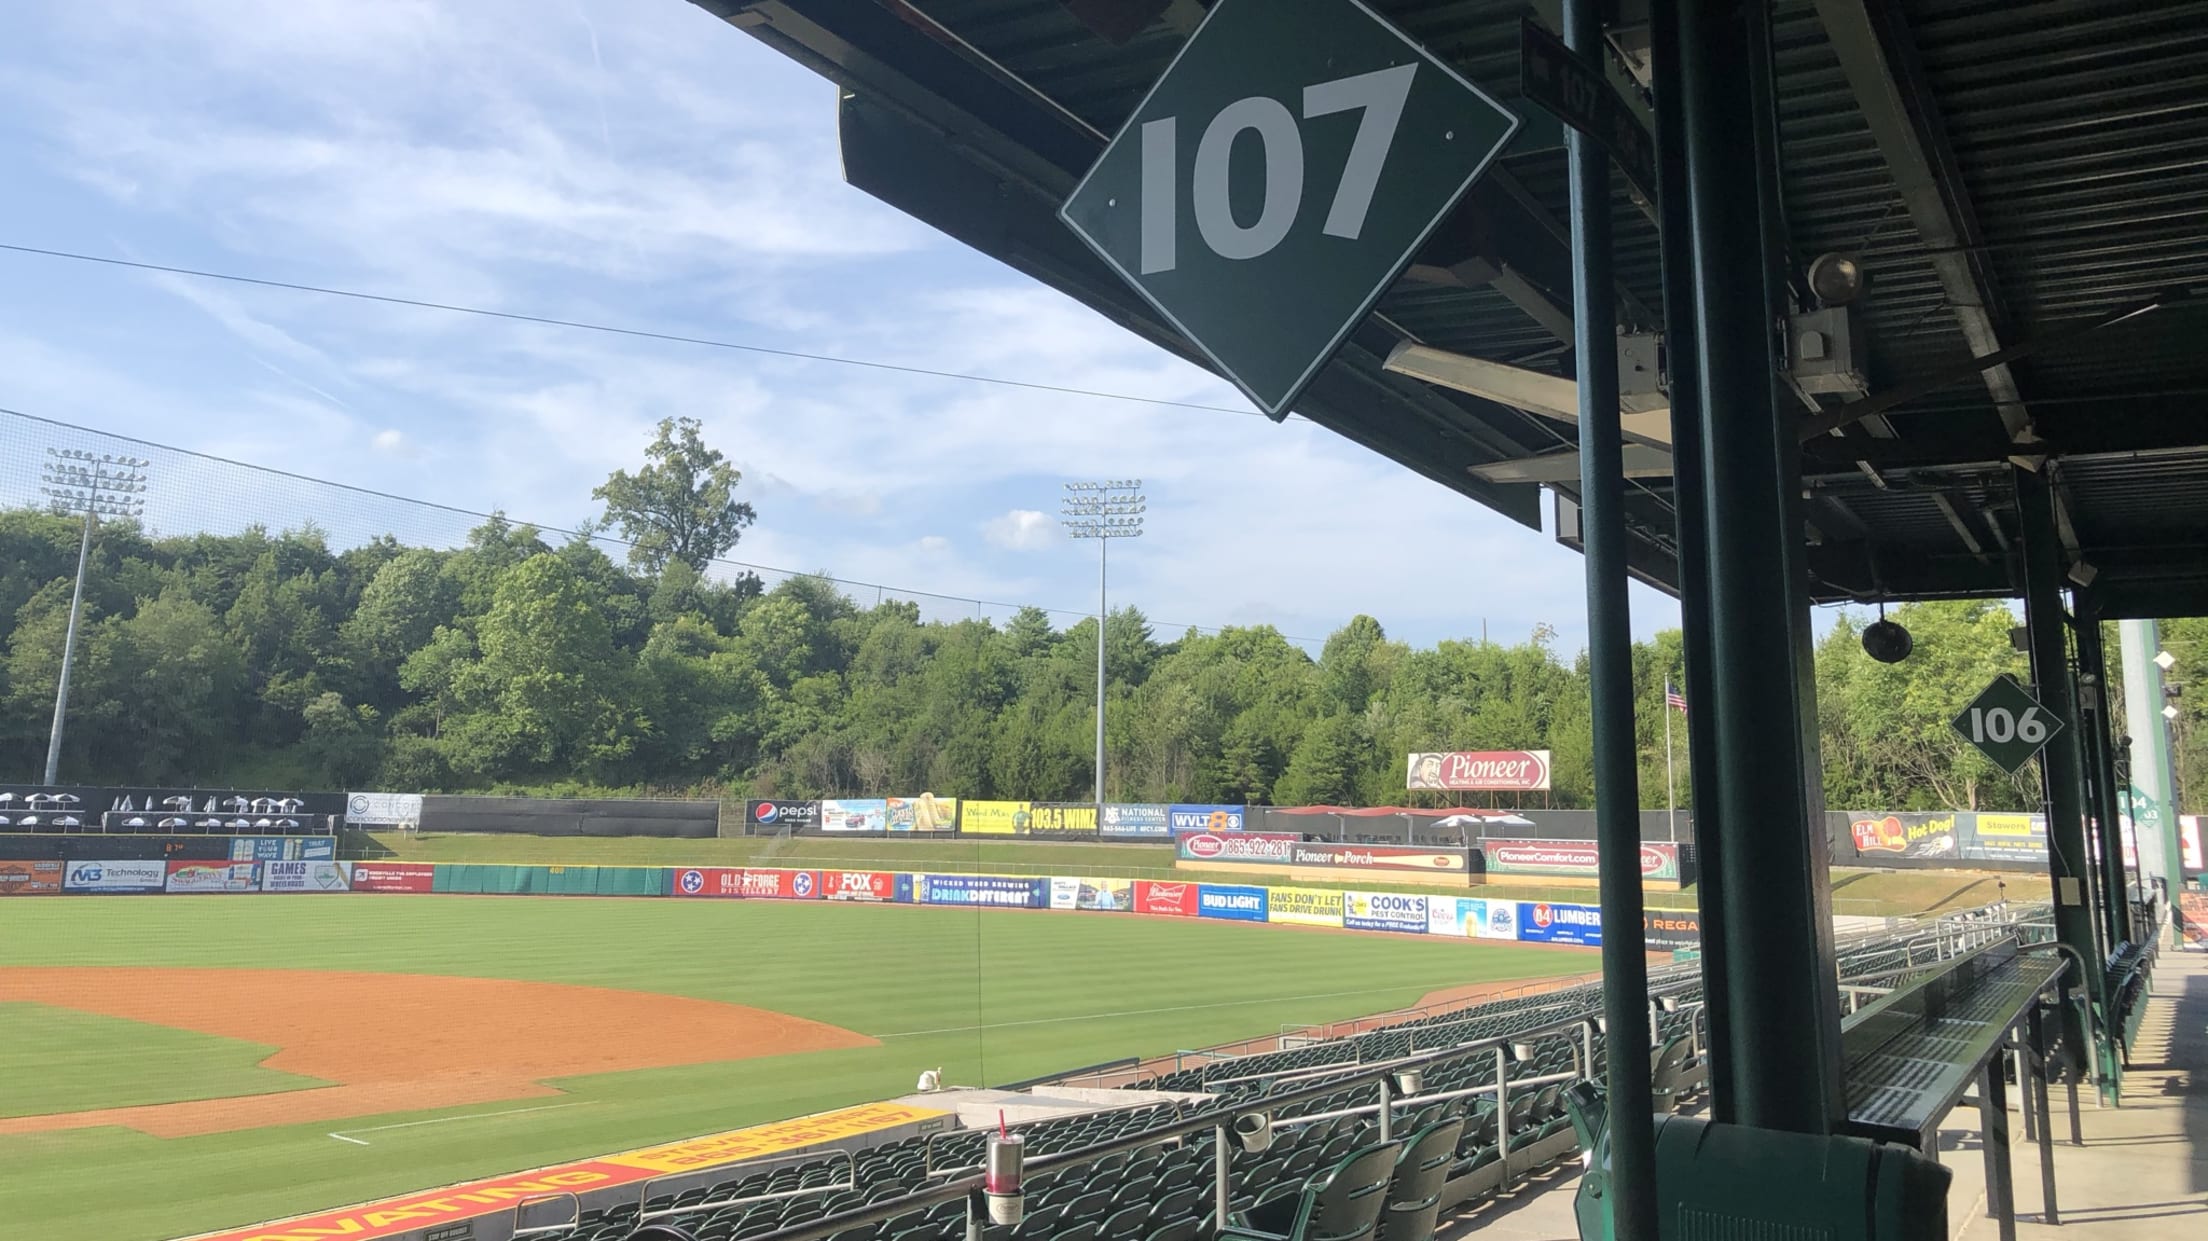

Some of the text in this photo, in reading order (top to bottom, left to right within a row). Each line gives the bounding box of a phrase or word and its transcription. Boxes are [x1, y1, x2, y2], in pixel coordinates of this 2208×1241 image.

[1141, 62, 1418, 275] 107
[1970, 707, 2047, 743] 106
[1449, 754, 1531, 779] Pioneer
[779, 804, 817, 818] pepsi
[1031, 807, 1097, 829] 103.5 WIMZ
[1121, 808, 1165, 817] NATIONAL
[1174, 811, 1228, 832] WVLT 8
[1907, 814, 1955, 840] Hot Dog!
[1856, 824, 1874, 836] ELM
[1193, 839, 1220, 850] Pioneer
[1296, 849, 1373, 864] Pioneer Porch
[1500, 851, 1596, 864] PioneerComfort.com
[106, 868, 159, 880] Technology
[271, 863, 307, 875] GAMES
[721, 874, 780, 888] OLD FORGE
[841, 873, 871, 891] FOX
[721, 886, 779, 895] DISTILLERY
[1150, 887, 1183, 898] Budweiser
[1202, 894, 1260, 910] BUD LIGHT
[1270, 892, 1293, 903] FANS
[1294, 893, 1322, 905] DON'T
[1325, 895, 1342, 906] LET
[1371, 896, 1425, 912] COOK'S
[1269, 903, 1342, 916] FANS DRIVE DRUNK
[1371, 910, 1425, 920] PEST CONTROL
[1536, 909, 1601, 926] 84 LUMBER
[1653, 919, 1698, 931] REGA
[637, 1107, 889, 1160] STEVE HOLBERT
